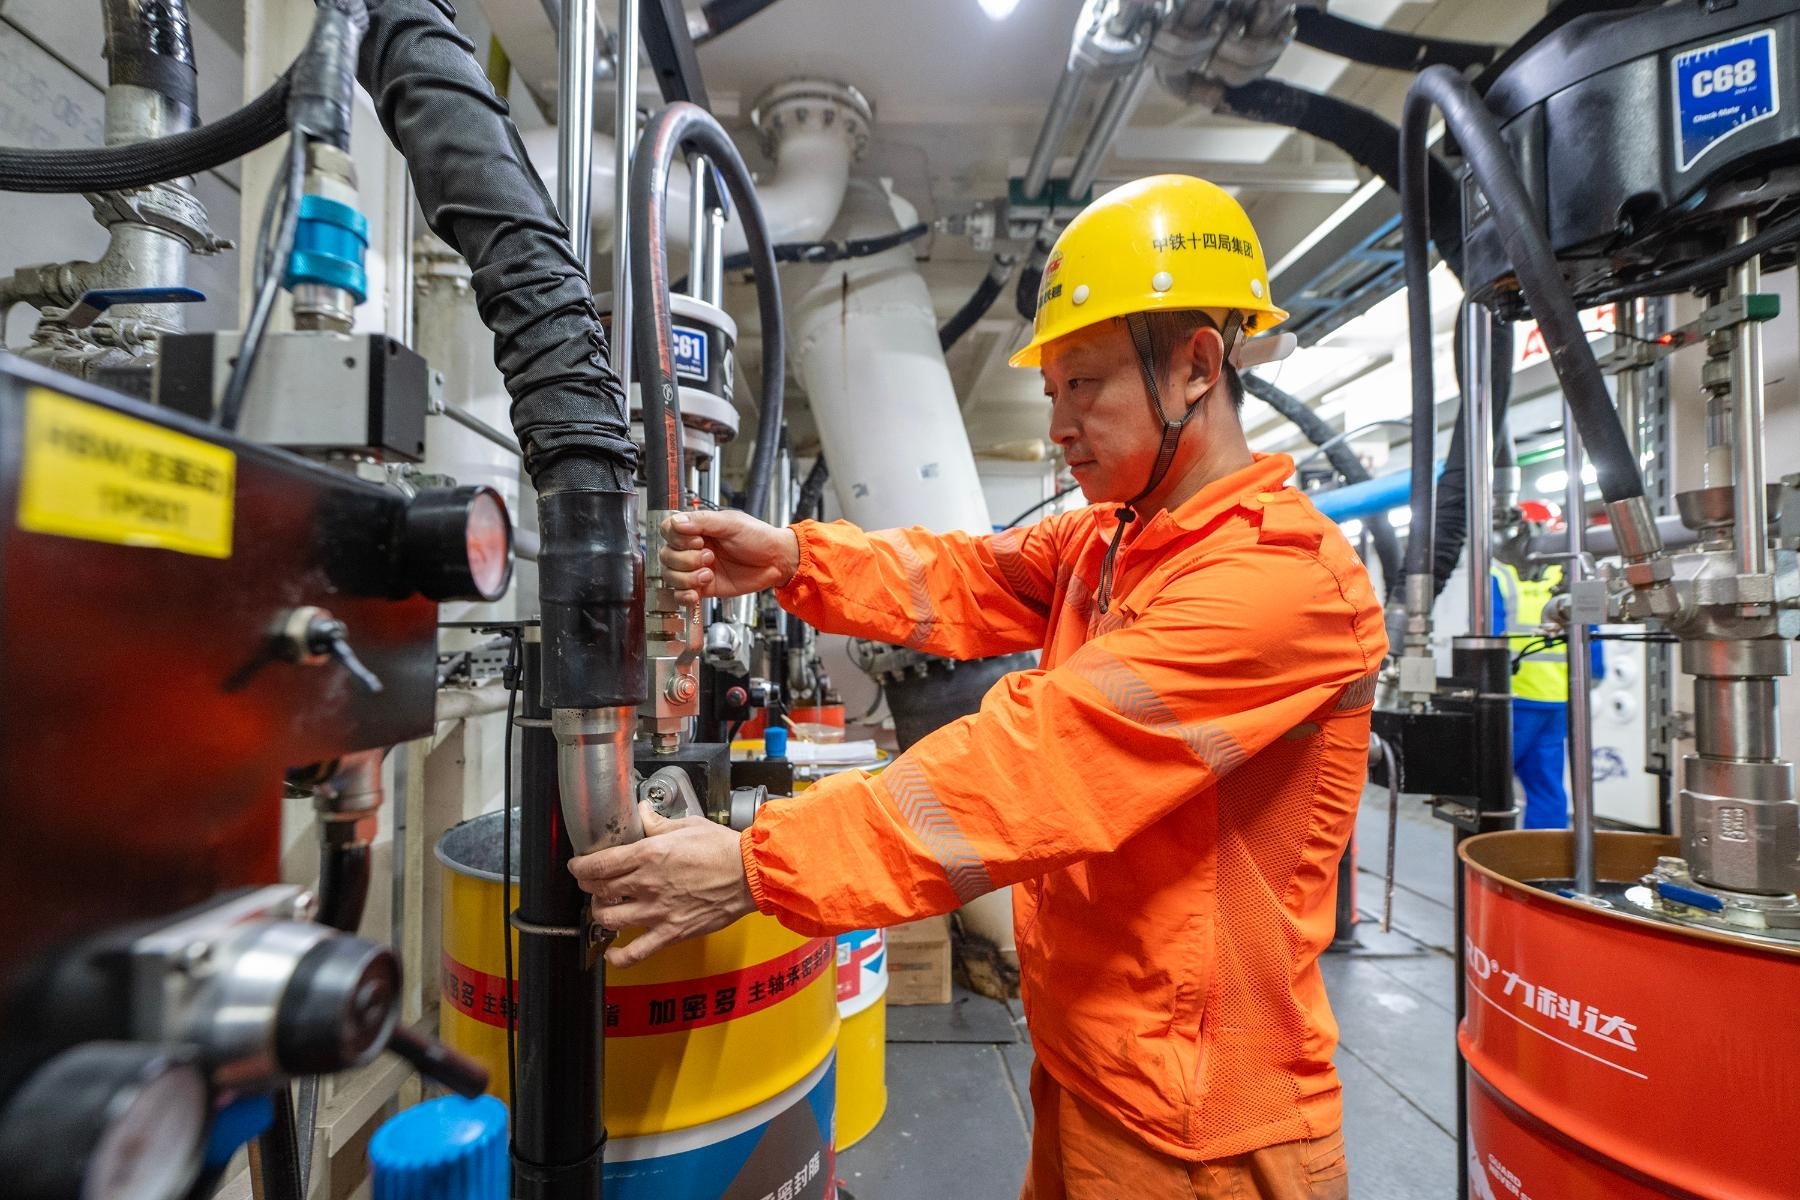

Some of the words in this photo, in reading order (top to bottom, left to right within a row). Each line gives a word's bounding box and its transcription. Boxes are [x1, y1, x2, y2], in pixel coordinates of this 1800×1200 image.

[1692, 58, 1757, 98] C68
[1153, 232, 1254, 259] 中铁十四局集团
[649, 987, 737, 1025] 加密多
[1501, 969, 1638, 1052] 力科达
